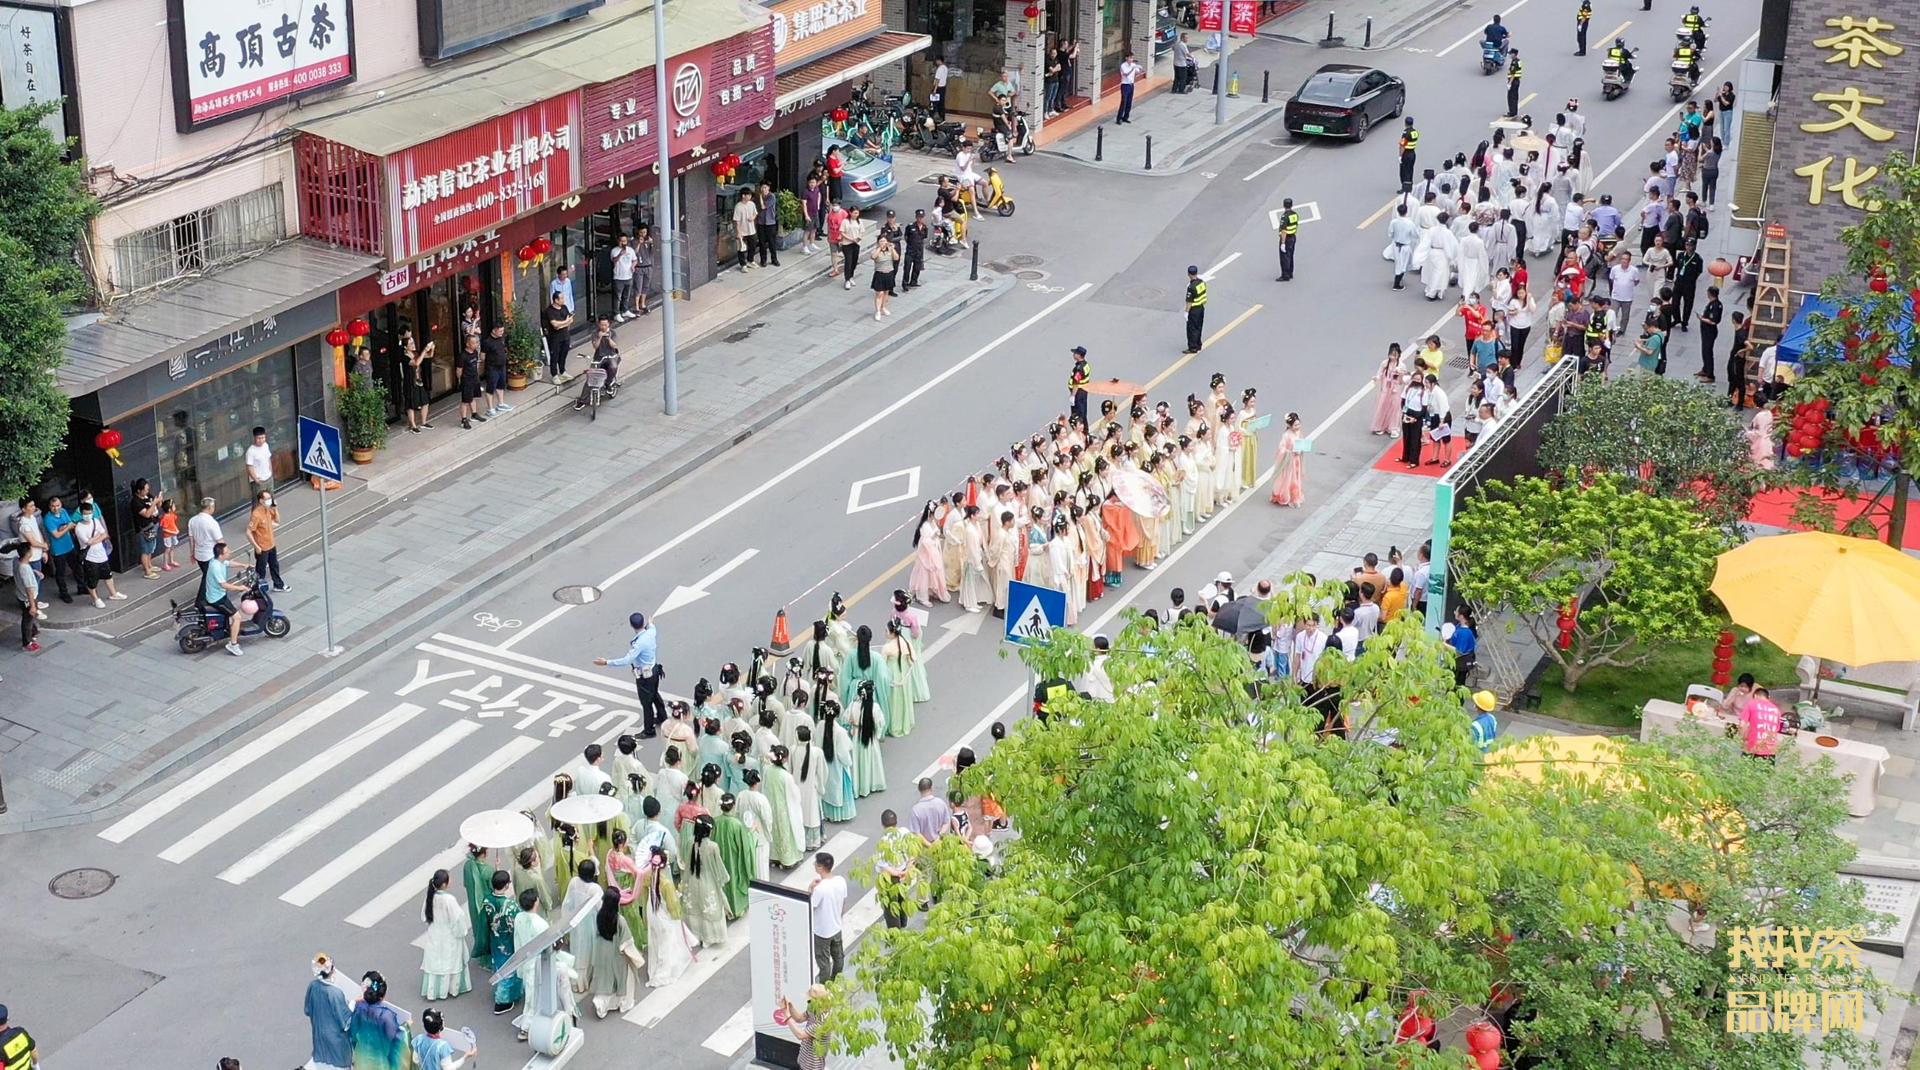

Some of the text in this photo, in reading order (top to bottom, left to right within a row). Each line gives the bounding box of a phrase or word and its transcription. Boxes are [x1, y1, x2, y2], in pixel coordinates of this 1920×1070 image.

[199, 2, 335, 78] 高頂古茶
[293, 72, 308, 85] 400
[309, 66, 327, 81] 0038
[328, 61, 342, 75] 333
[609, 97, 637, 120] 专业
[1794, 15, 1904, 212] 茶文化
[601, 119, 649, 151] 私人订制
[402, 125, 570, 211] 勐海信记茶业有限公司
[386, 270, 408, 291] 古树
